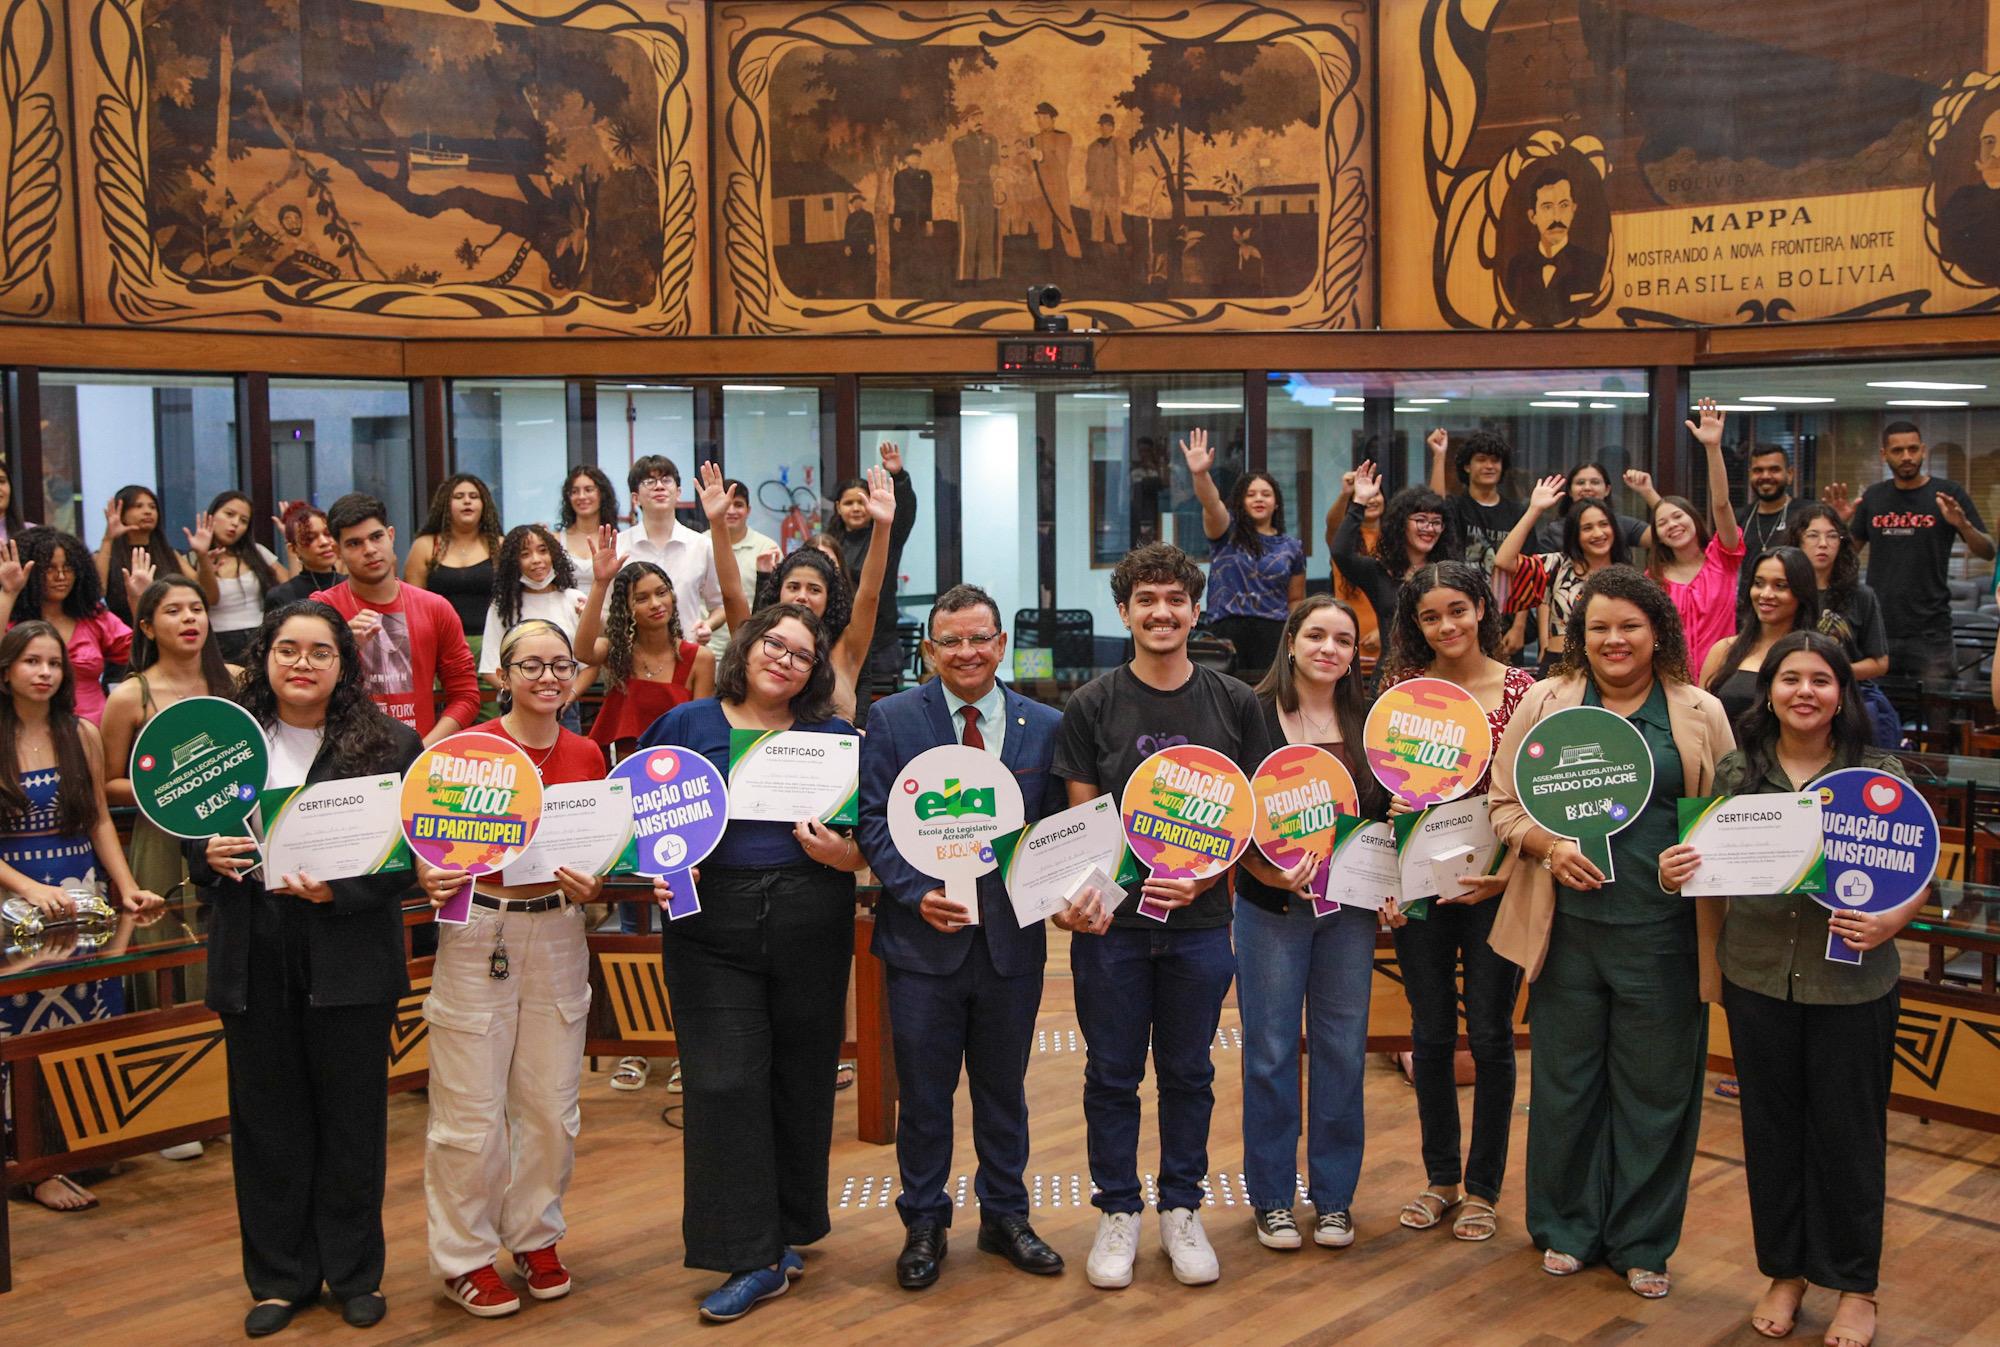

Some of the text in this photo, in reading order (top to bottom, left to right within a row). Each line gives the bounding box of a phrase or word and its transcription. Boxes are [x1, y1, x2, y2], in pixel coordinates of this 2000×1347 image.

[1668, 174, 1745, 192] BOLIVIA
[1690, 205, 1812, 234] MAPPA
[1626, 231, 1895, 267] MOSTRANDO A NOVA FRONTEIRA NORTE
[1636, 273, 1734, 297] BRASIL
[1778, 263, 1895, 288] BOLIVIA
[389, 703, 415, 718] YORK
[1388, 710, 1466, 748] REDAÇÃO
[765, 746, 825, 757] CERTIFICADO
[1395, 740, 1460, 770] NOTA 1000
[153, 739, 248, 797] ASSEMBLEIA LEGISLATIVA DO
[156, 747, 255, 808] ESTADO DO ACRE
[430, 754, 517, 789] REDAÇÃO
[1154, 759, 1235, 806] REDAÇÃO
[1532, 763, 1635, 783] ASSEMBLEIA LEGISLATIVA DO
[632, 775, 711, 814] CAÇÃO QUE
[1263, 777, 1332, 818] REDAÇÃO
[1532, 772, 1638, 796] ESTADO DO ACRE
[298, 795, 365, 812] CERTIFICADO
[439, 785, 512, 816] NOTA 1000
[544, 798, 597, 811] ERTIFICADO
[1159, 793, 1227, 829] NOTA 1000
[415, 816, 436, 837] EU
[437, 819, 521, 844] PARTICIPEI!
[634, 799, 714, 839] ANSFORMA
[918, 823, 998, 836] Escola do Legislativo
[1280, 802, 1335, 836] NOTA 1000
[1425, 814, 1473, 833] CERTIFICADO
[1716, 811, 1782, 823] CERTIFICADO
[1823, 811, 1925, 848] UCAÇÃO QUE
[942, 832, 975, 841] Acreano
[1028, 822, 1086, 850] CERTIFICADO
[1132, 814, 1231, 858] EU PARTICIPEI!
[1361, 834, 1398, 850] CERTIFICA
[1824, 841, 1916, 873] ANSFORMA
